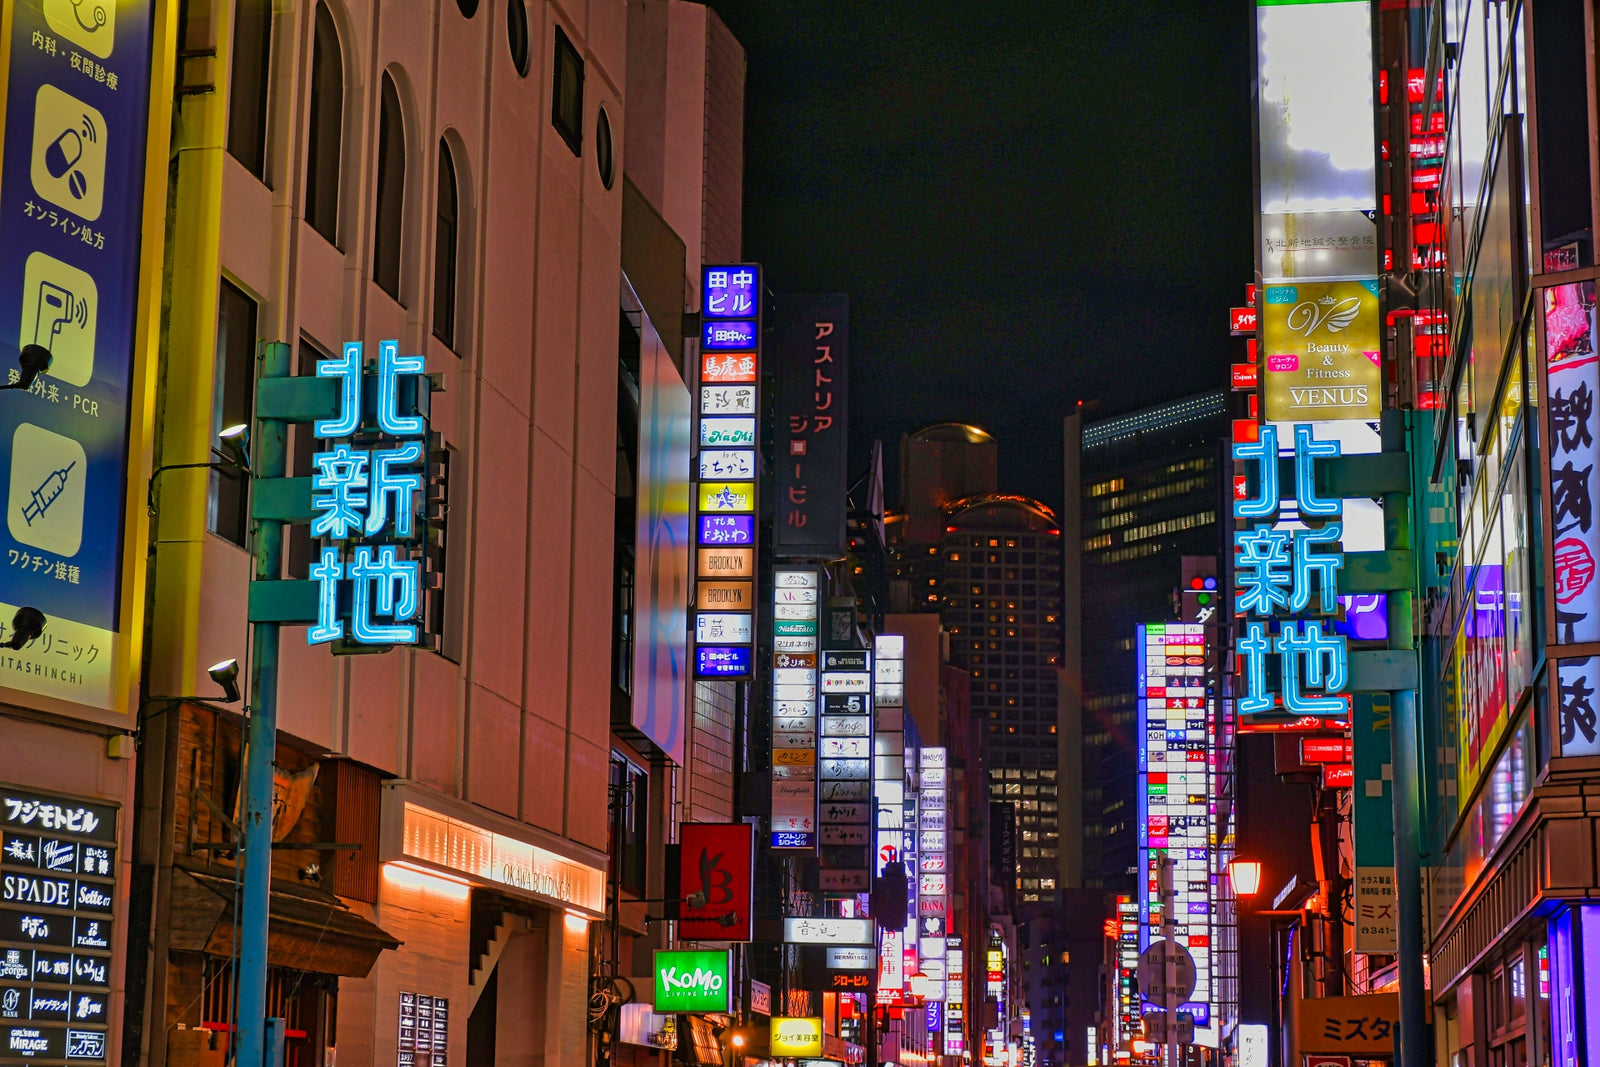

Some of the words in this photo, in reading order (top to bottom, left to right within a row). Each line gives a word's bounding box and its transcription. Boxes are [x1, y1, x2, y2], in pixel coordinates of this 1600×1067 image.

[31, 30, 118, 91] 内科・夜間診療
[1368, 211, 1375, 220] 6
[24, 201, 106, 250] オンライン処方
[1276, 235, 1374, 248] 北新地鍼灸整骨院
[708, 270, 753, 289] 田中
[1370, 283, 1377, 291] 5
[708, 294, 752, 313] ビル
[1306, 342, 1349, 354] Beauty
[1322, 356, 1334, 366] &
[1371, 353, 1378, 361] 4
[814, 322, 834, 433] アストリア
[1306, 368, 1350, 378] Fitness
[1289, 387, 1368, 404] VENUS
[708, 430, 753, 443] NaMi
[712, 459, 749, 475] ちから
[307, 339, 426, 645] 北新地
[707, 494, 747, 504] NASH
[8, 549, 81, 585] ワクチン接種
[708, 555, 743, 570] BROOKLYN
[1232, 424, 1349, 715] 北新地
[707, 589, 742, 603] BROOKLYN
[1148, 731, 1165, 739] KOH
[4, 798, 99, 834] フジモトビル
[503, 863, 531, 890] OKAWA
[4, 875, 70, 906] SPADE
[1361, 905, 1397, 919] ミズ
[833, 975, 869, 987] ジロービル
[666, 990, 697, 998] LIVING
[10, 1037, 49, 1051] MIRAGE
[774, 1033, 819, 1043] ジョイ美容室
